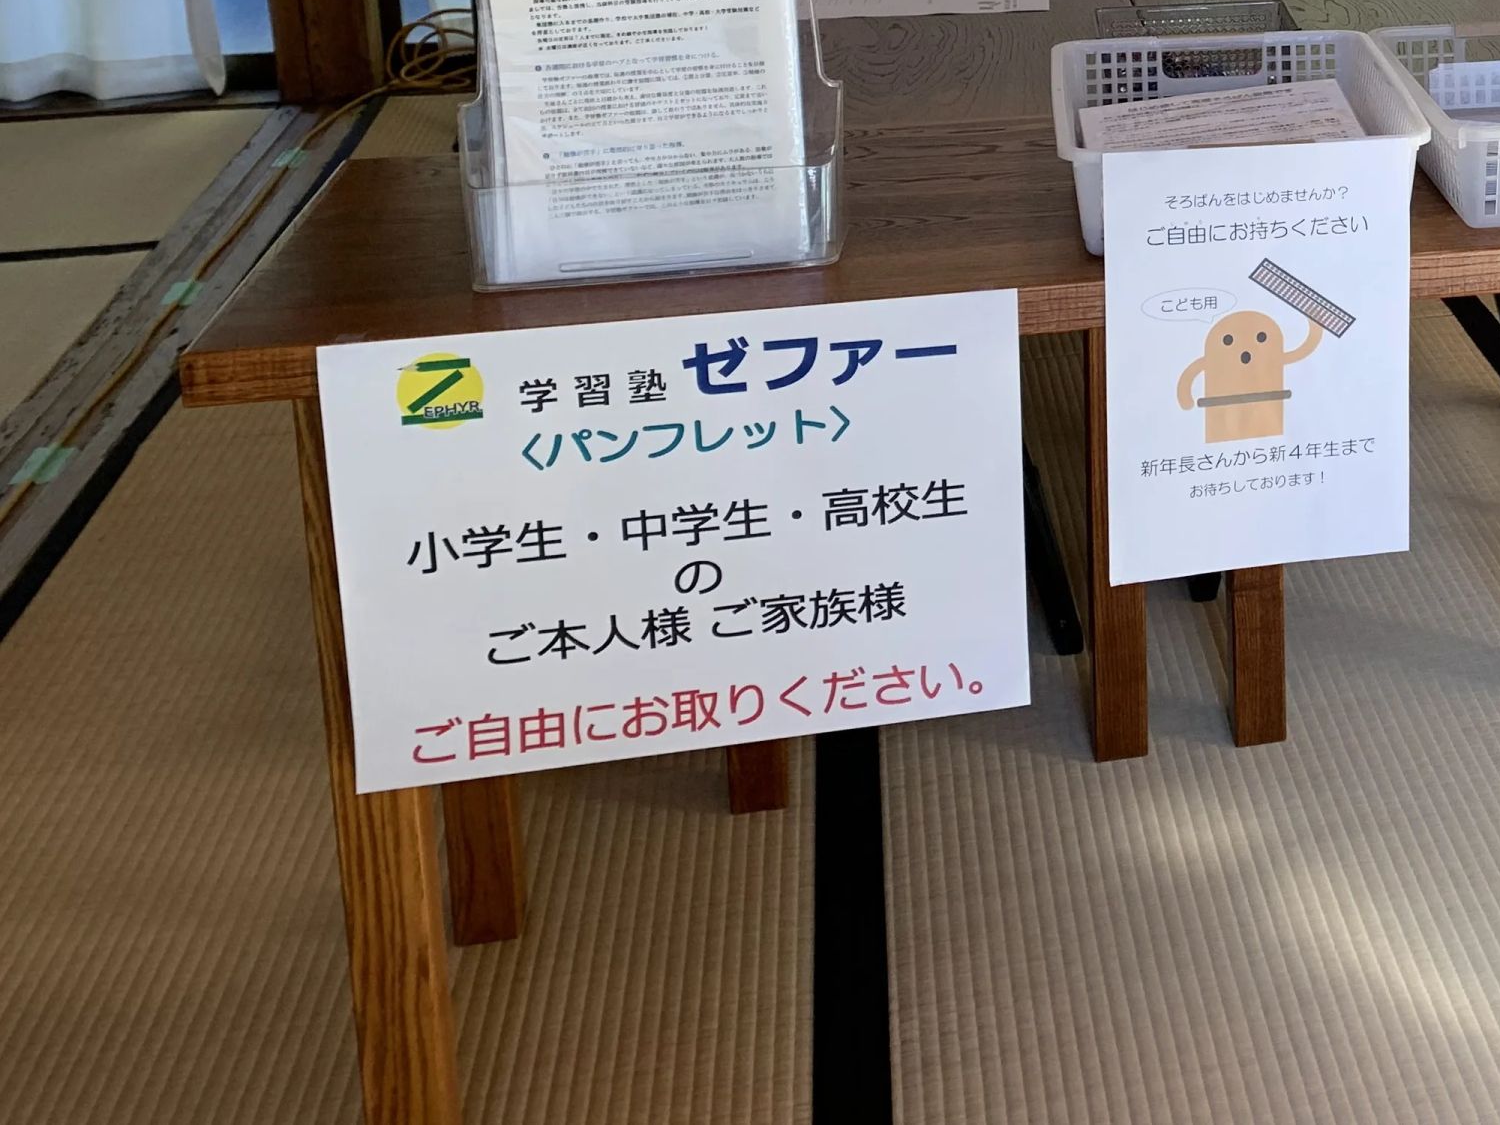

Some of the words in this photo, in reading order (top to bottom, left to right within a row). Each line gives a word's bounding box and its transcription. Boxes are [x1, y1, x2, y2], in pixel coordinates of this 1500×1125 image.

[1164, 185, 1350, 210] そろばんをはじめませんか？
[1146, 215, 1369, 247] ご自由にお持ちください
[1160, 295, 1218, 314] こども用
[518, 368, 667, 414] 学習塾
[682, 335, 958, 396] ゼファー
[1140, 436, 1377, 478] 新年長さんから新４年生まで
[1189, 470, 1326, 499] お待ちしております！
[405, 478, 970, 575] 小学生・中学生・高校生
[673, 559, 724, 596] の
[486, 605, 692, 665] ご本人様
[709, 581, 908, 640] ご家族様
[410, 661, 984, 765] ご自由にお取りください。
